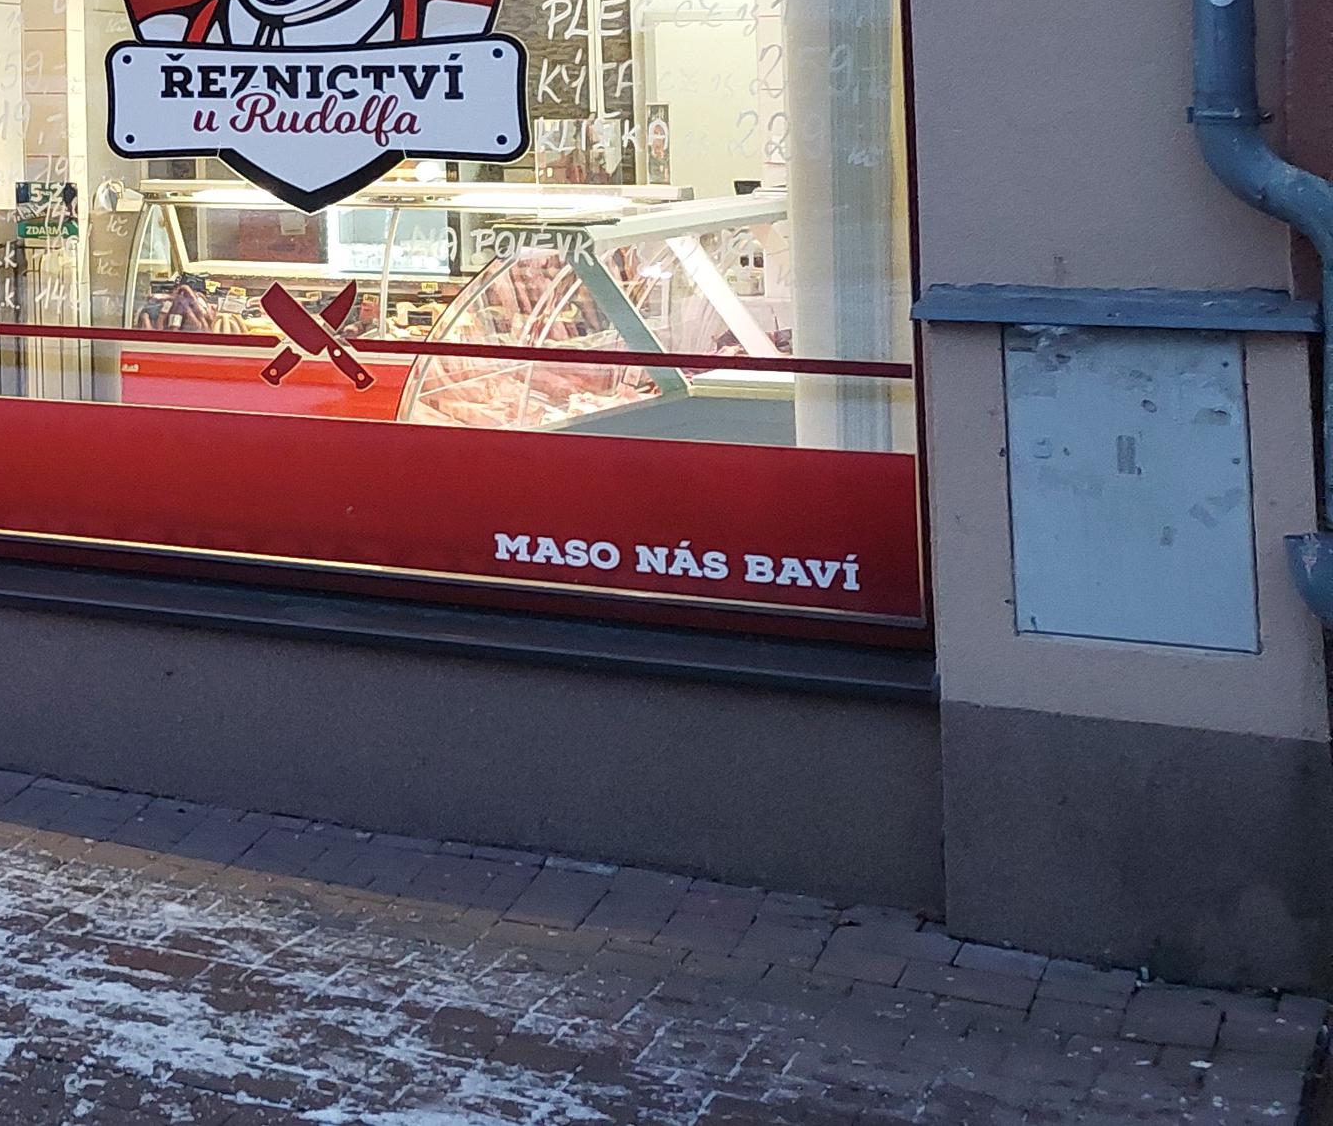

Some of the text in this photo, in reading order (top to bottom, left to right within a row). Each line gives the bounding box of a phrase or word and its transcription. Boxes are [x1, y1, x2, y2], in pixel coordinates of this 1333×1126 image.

[160, 53, 465, 100] ŘEZNICTVÍ
[193, 90, 421, 147] u Rudolfa
[494, 533, 860, 591] MASO NÁS BAVÍ
